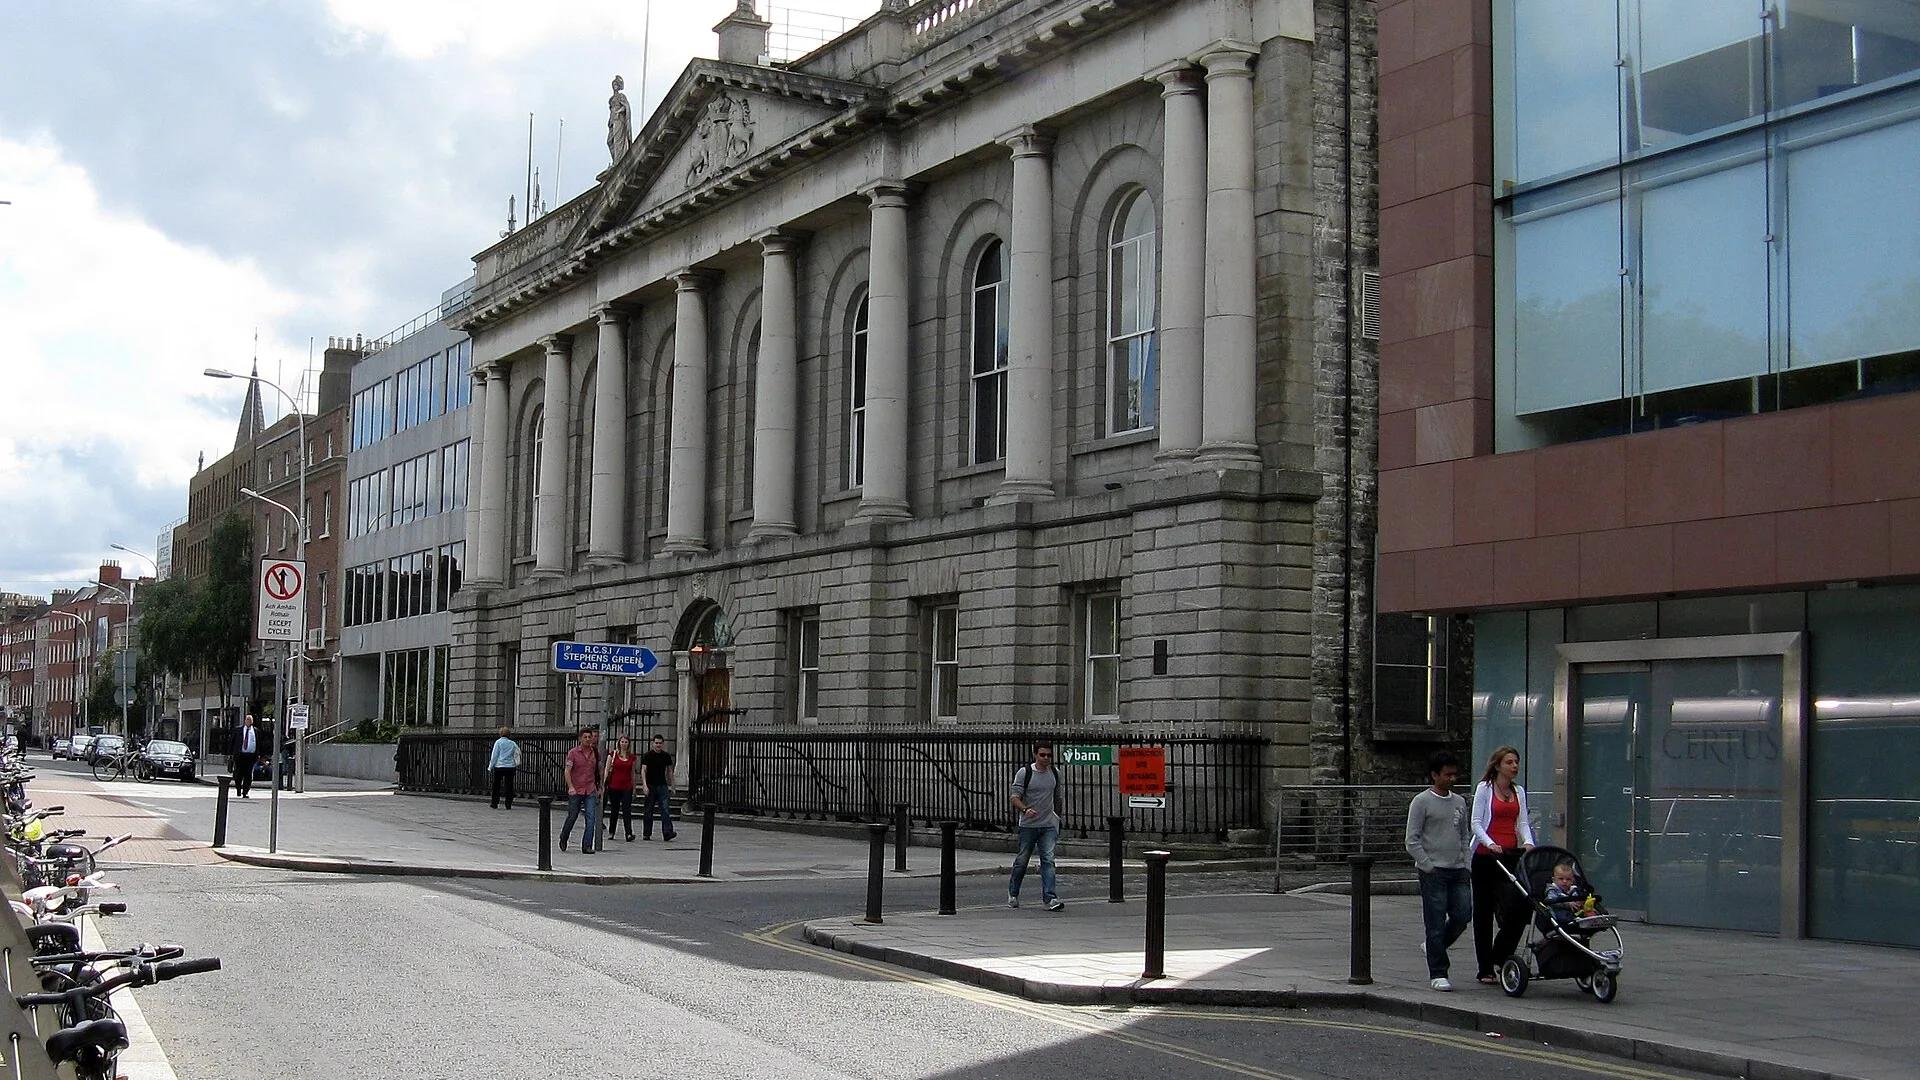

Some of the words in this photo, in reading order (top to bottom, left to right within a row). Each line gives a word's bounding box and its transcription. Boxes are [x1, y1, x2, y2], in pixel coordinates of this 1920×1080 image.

[563, 652, 608, 662] STEPHENS
[611, 655, 642, 664] GREEN
[580, 662, 598, 670] CAR
[601, 663, 624, 672] PARK
[1074, 748, 1101, 761] bam
